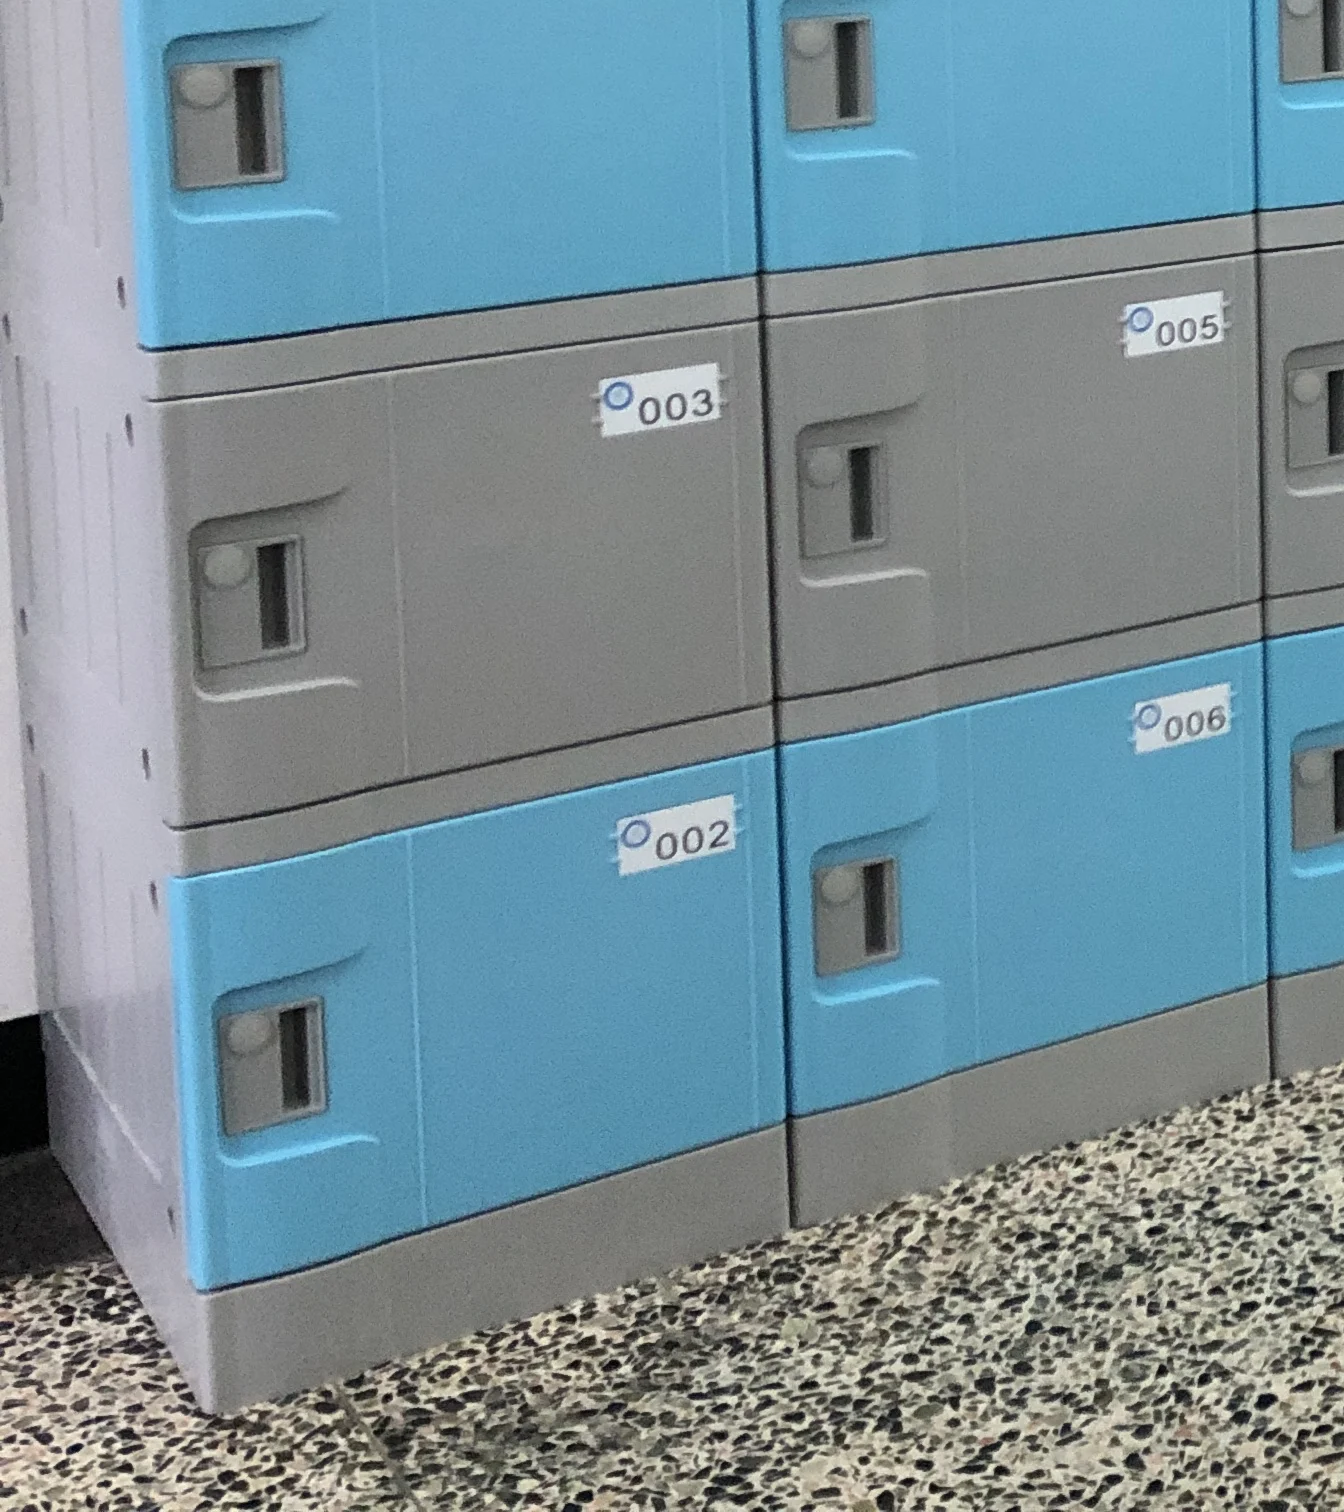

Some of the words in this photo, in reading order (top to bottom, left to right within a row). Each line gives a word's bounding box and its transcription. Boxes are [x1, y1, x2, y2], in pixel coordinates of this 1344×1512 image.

[1155, 312, 1220, 348] 005
[638, 387, 714, 426] 003
[1163, 704, 1228, 744] 006
[654, 819, 731, 862] 002
